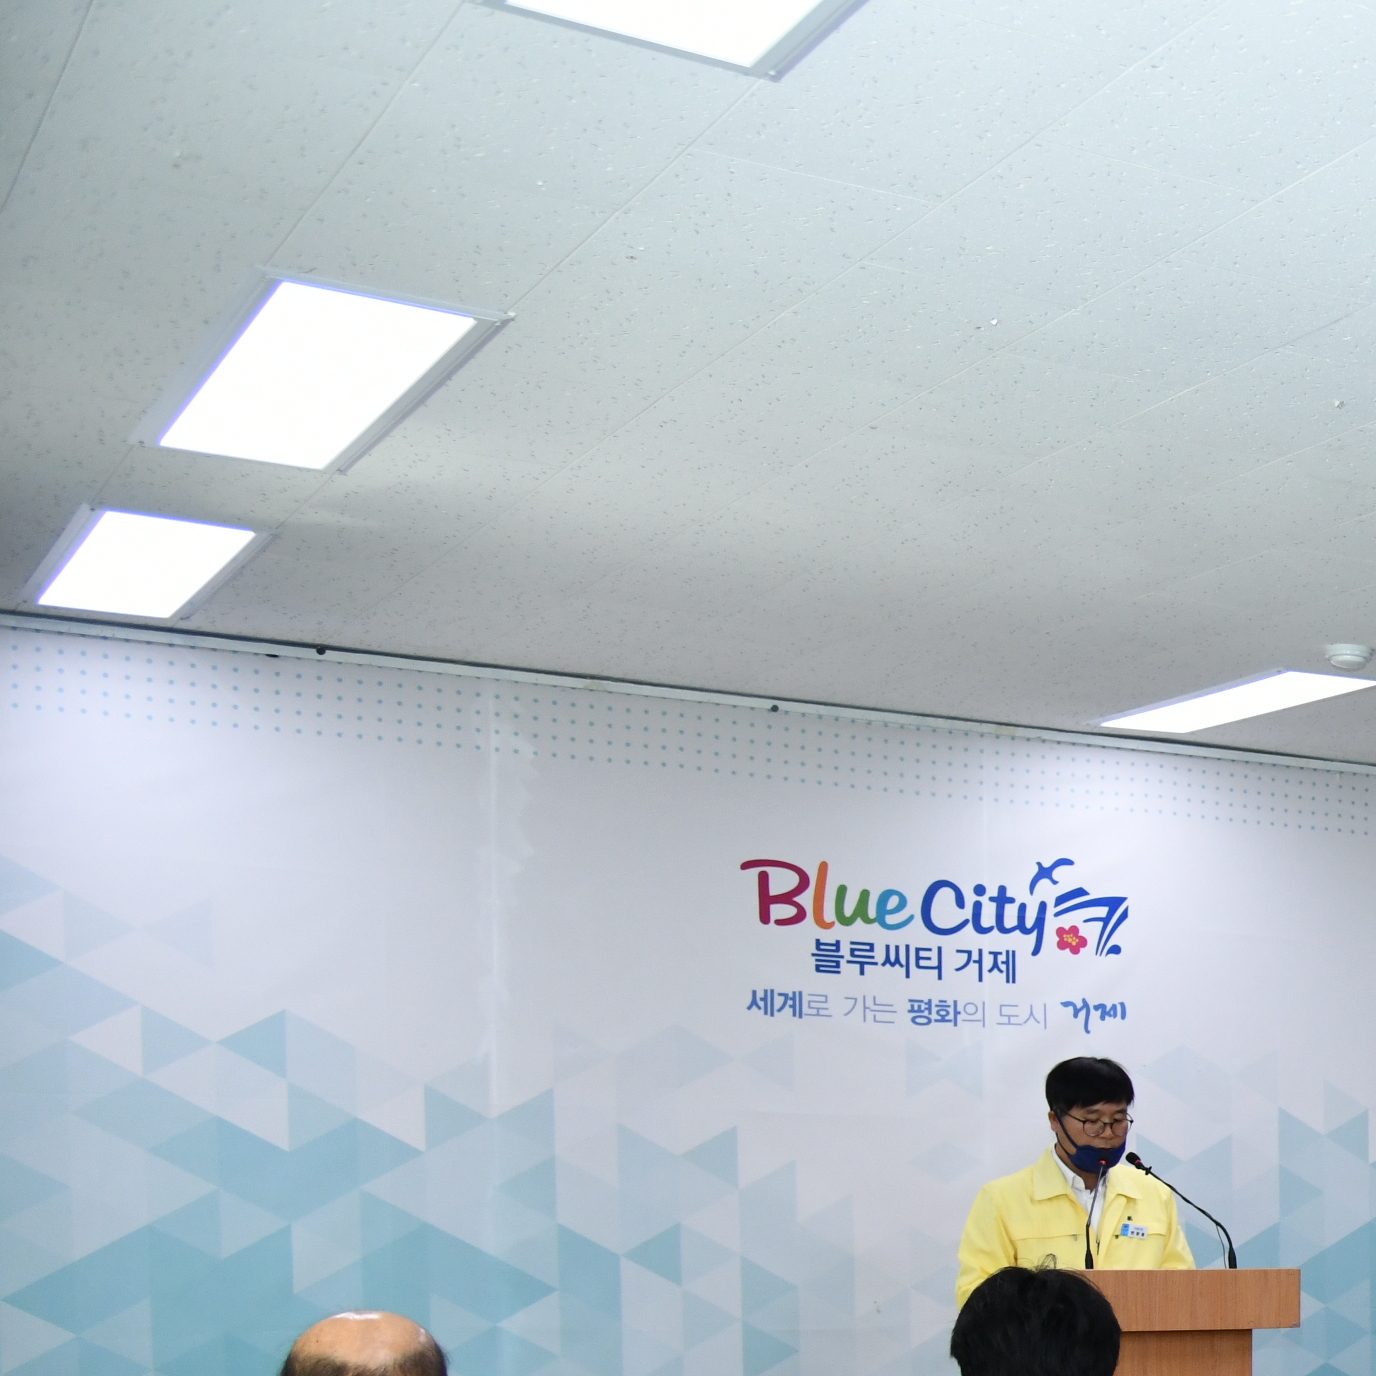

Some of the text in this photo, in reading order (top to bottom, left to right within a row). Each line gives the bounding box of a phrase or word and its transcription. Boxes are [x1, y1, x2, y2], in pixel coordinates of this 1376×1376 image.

[740, 858, 1047, 957] Blue City
[810, 938, 1017, 984] 블루씨티 거제
[746, 988, 1127, 1034] 세계로 가는 평화의 도시 거제
